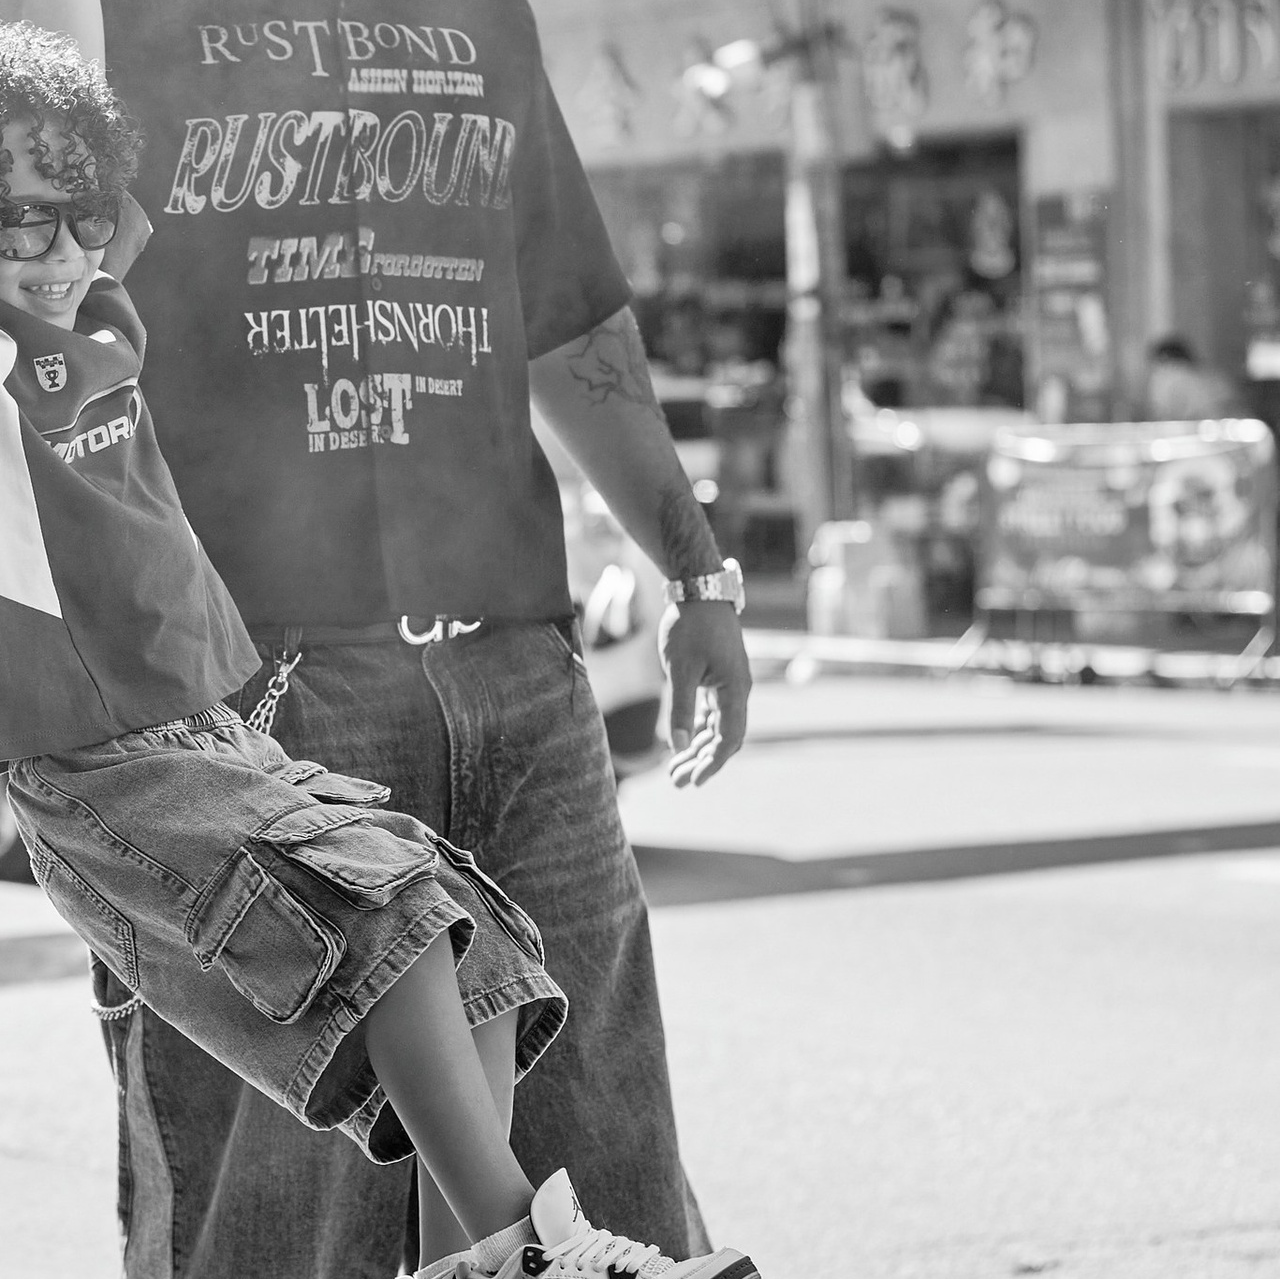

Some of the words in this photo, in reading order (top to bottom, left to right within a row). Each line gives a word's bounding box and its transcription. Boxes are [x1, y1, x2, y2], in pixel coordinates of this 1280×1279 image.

[348, 67, 408, 94] ASHEN
[412, 69, 484, 98] HORIZON
[371, 253, 485, 282] FORGOTTEN
[415, 375, 426, 393] IN
[427, 377, 463, 397] DESERT
[303, 373, 413, 445] LOST
[308, 433, 325, 453] IN
[328, 424, 385, 451] DESER
